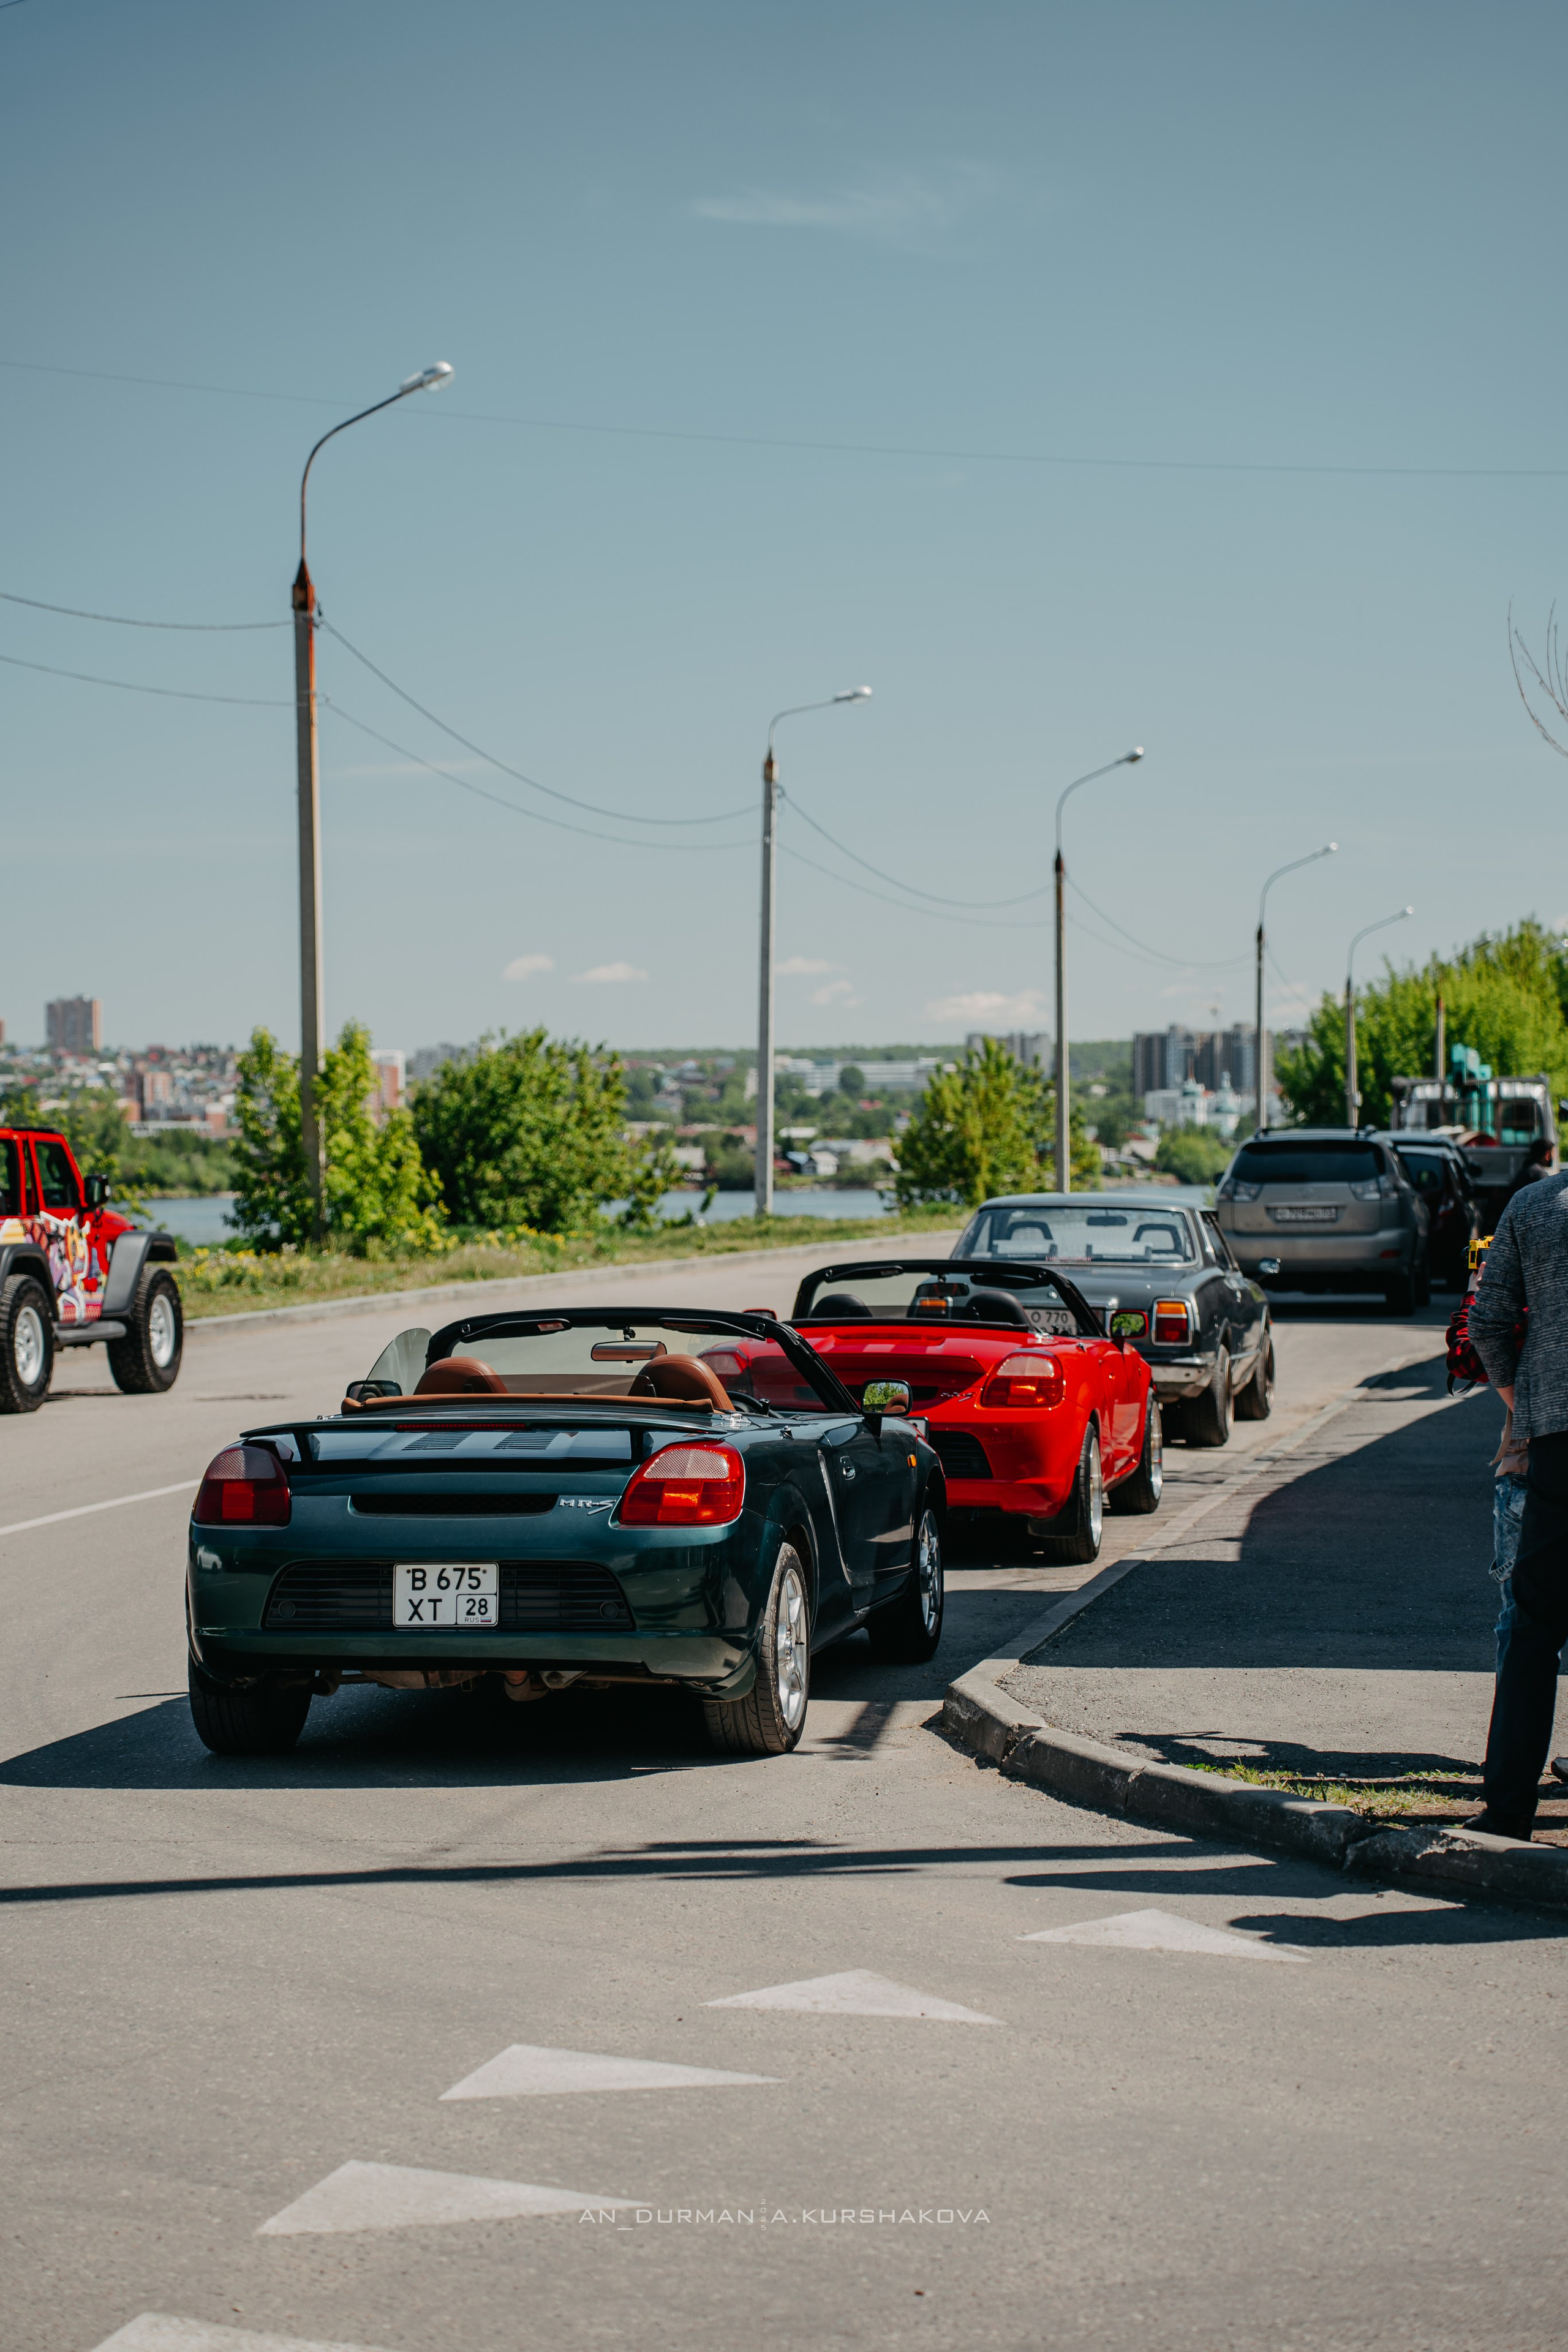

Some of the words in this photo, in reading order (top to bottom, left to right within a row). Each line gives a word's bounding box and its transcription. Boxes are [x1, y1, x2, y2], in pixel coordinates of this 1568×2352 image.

[1046, 1311, 1069, 1324] 770
[437, 1567, 481, 1591] 675
[466, 1598, 488, 1616] 28
